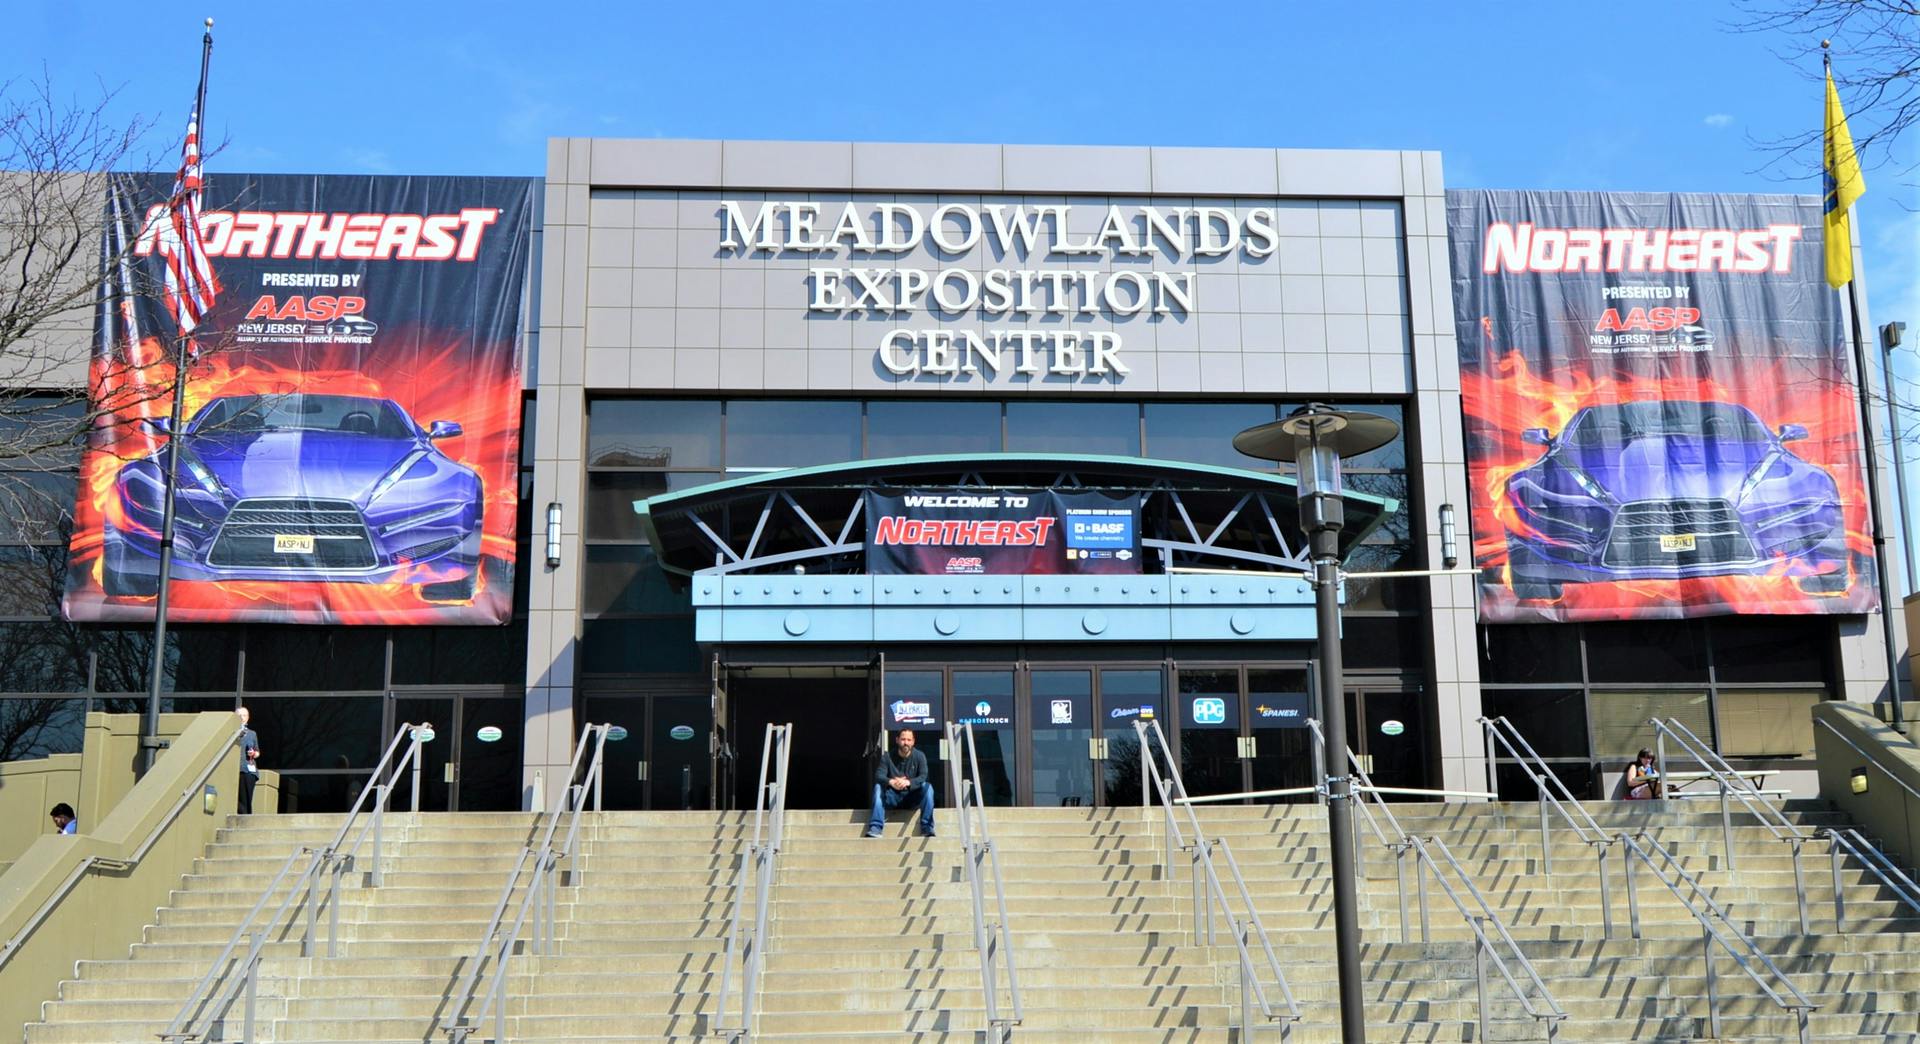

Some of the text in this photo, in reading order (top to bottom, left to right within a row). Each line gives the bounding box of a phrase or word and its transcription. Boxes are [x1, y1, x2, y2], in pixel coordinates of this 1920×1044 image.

[133, 203, 498, 262] NORTHEAST
[719, 200, 1279, 257] MEADOWLANDS
[1483, 221, 1801, 275] NORTHEAST
[262, 273, 361, 287] PRESENTED BY
[808, 267, 1197, 314] EXPOSITION
[1602, 286, 1690, 300] PRESENTED BY
[245, 295, 366, 321] AASP
[1595, 306, 1700, 332] AASP
[237, 324, 307, 334] NEW JERSEY
[334, 336, 372, 344] PROVIDERS
[1590, 334, 1651, 345] NEW JERSEY
[878, 328, 1130, 376] CENTER
[1679, 344, 1713, 352] PROVIDERS
[904, 496, 1029, 508] WELCOME TO
[874, 516, 1054, 547] NORTHEAST
[1091, 522, 1124, 534] BASF
[947, 557, 982, 566] AASP
[1196, 701, 1224, 720] PPG
[1262, 709, 1299, 717] SPANESI
